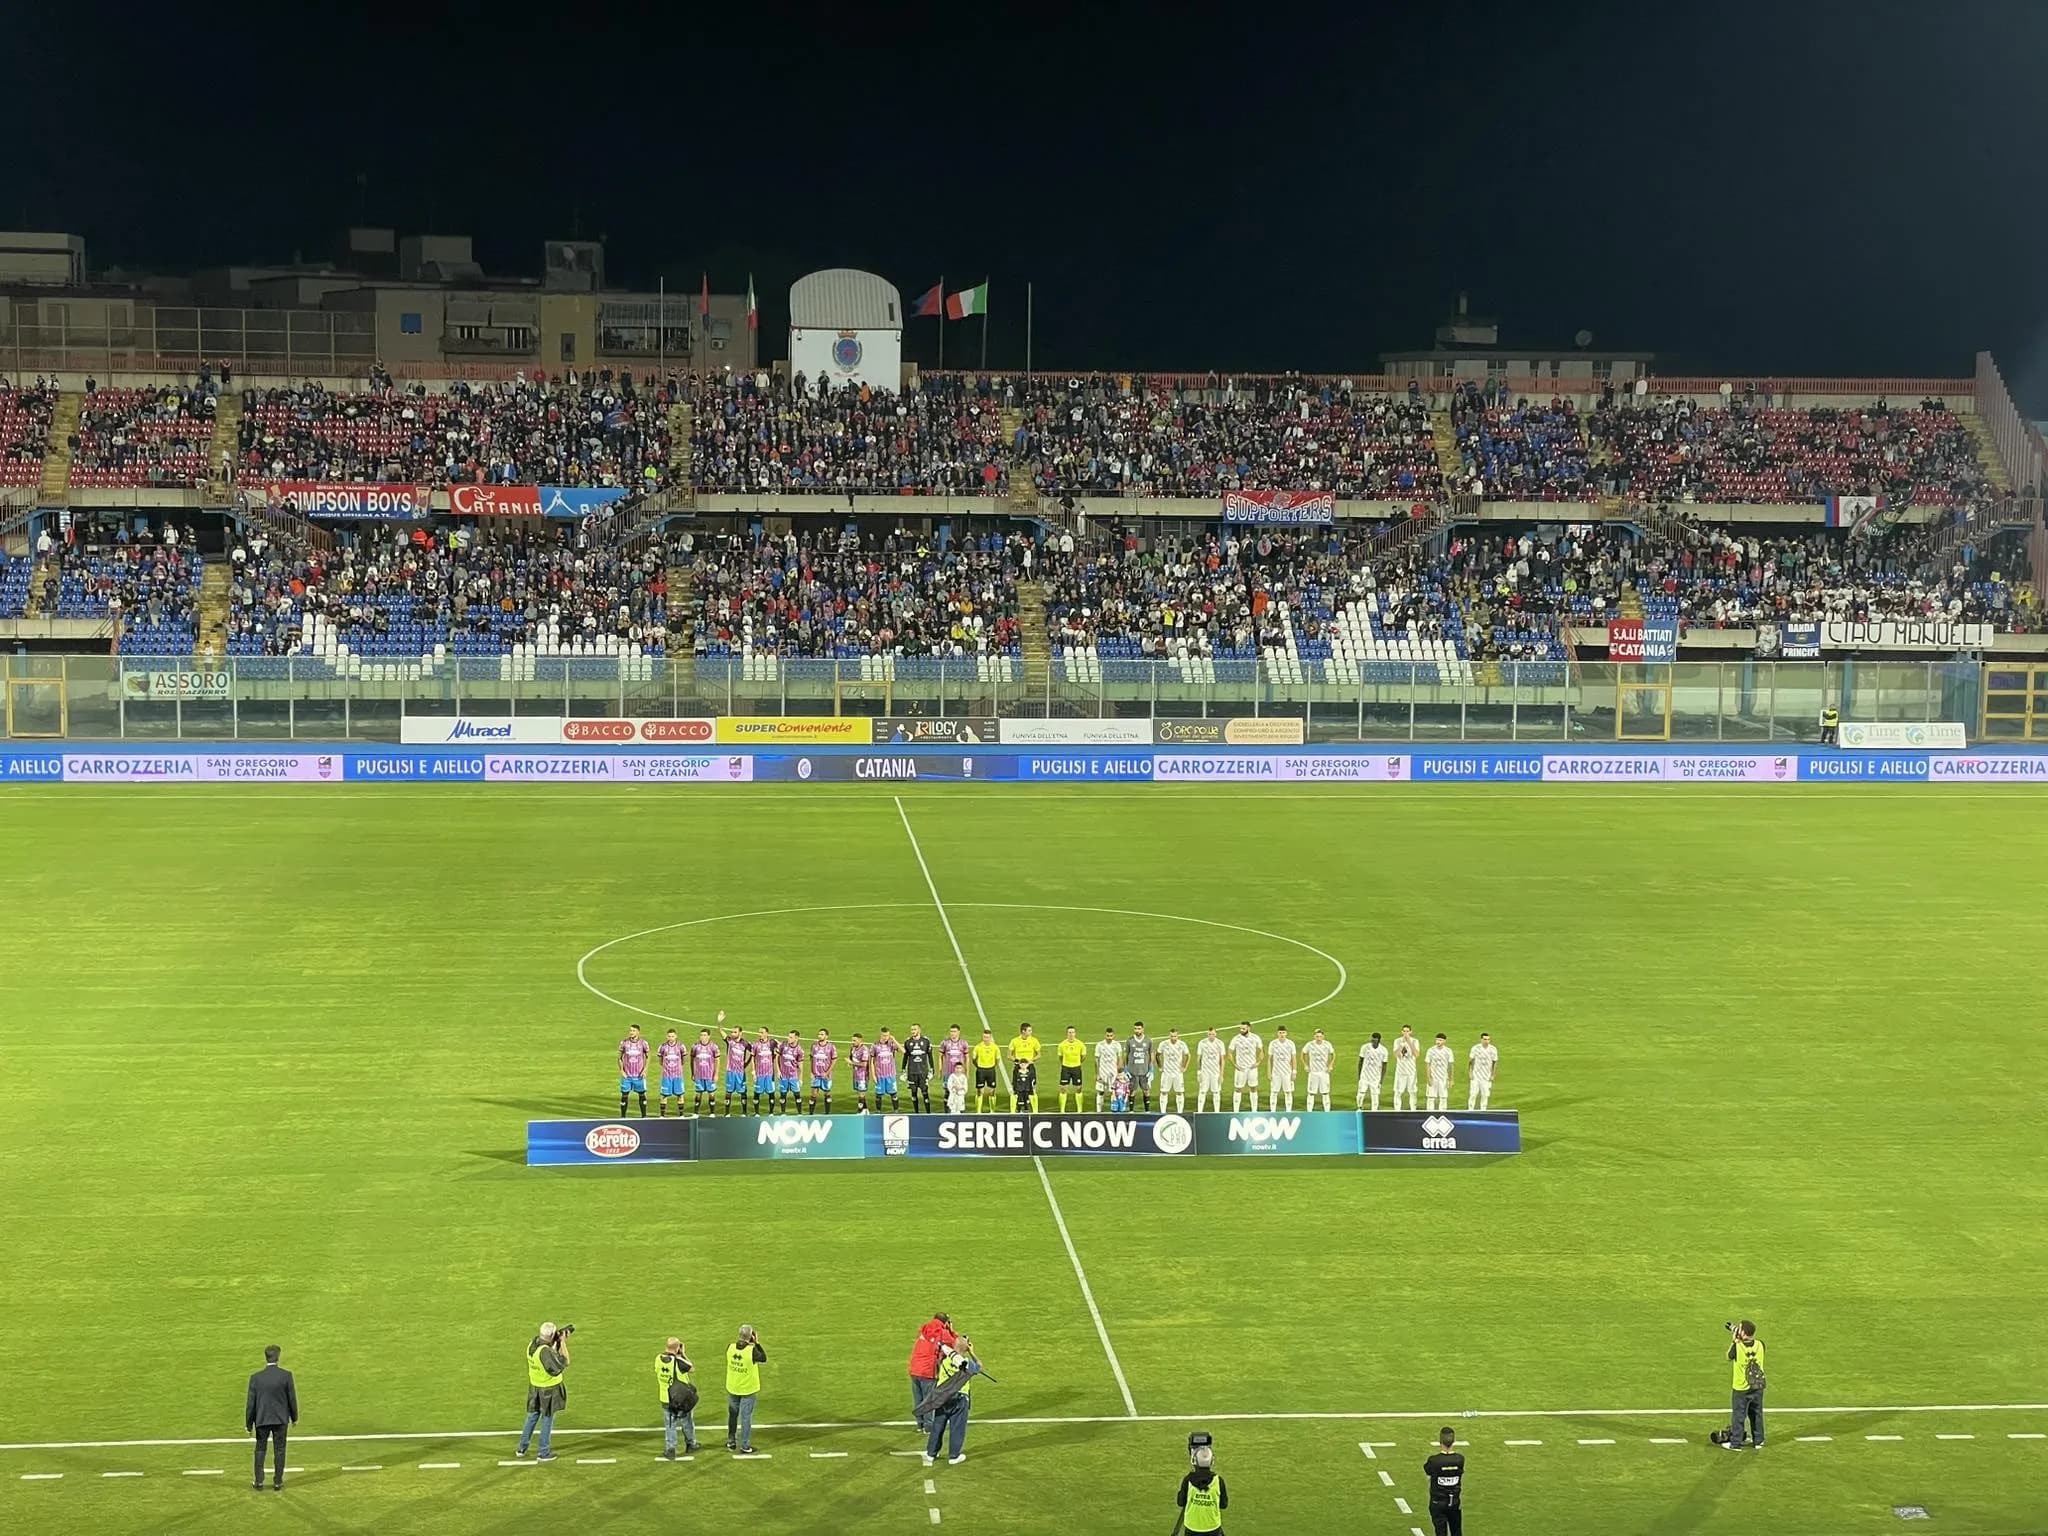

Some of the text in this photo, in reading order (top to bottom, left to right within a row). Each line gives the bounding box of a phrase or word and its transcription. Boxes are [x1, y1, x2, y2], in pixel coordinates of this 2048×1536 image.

[288, 491, 411, 512] SIMPSON BOYS
[454, 487, 543, 514] CATANIA
[1226, 493, 1333, 521] SUPPORTERS
[1638, 628, 1672, 641] BATTIATI
[1618, 643, 1666, 656] CATANIA
[1783, 648, 1820, 656] PRINCIPE
[156, 673, 228, 688] ASSORO
[446, 719, 511, 741] Muracel
[582, 726, 632, 735] BACCO
[659, 726, 709, 735] BACCO
[1868, 725, 1900, 736] Time
[1928, 724, 1960, 736] Time
[9, 760, 60, 774] AIELLO
[68, 760, 193, 774] CARROZZERIA
[207, 759, 298, 767] SAN GREGORIO
[357, 760, 483, 774] PUGLISI E AIELLO
[490, 760, 608, 774] CARROZZERIA
[622, 759, 710, 767] SAN GREGORIO
[855, 758, 916, 778] CATANIA
[1032, 760, 1151, 774] PUGLISI E AIELLO
[1158, 760, 1272, 774] CARROZZERIA
[1285, 759, 1369, 767] SAN GREGORIO
[1423, 760, 1540, 774] PUGLISI E AIELLO
[1548, 760, 1660, 774] CARROZZERIA
[1673, 759, 1756, 767] SAN GREGORIO
[1810, 760, 1926, 774] PUGLISI E AIELLO
[1933, 760, 2045, 774] CARROZZERIA
[219, 769, 287, 777] DI CATANIA
[634, 769, 699, 777] DI CATANIA
[1296, 769, 1359, 777] DI CATANIA
[1683, 769, 1745, 777] DI CATANIA
[757, 1119, 832, 1145] NOW
[938, 1121, 1136, 1149] SERIE C NOW
[1228, 1116, 1301, 1141] NOW
[590, 1131, 637, 1149] Beretta
